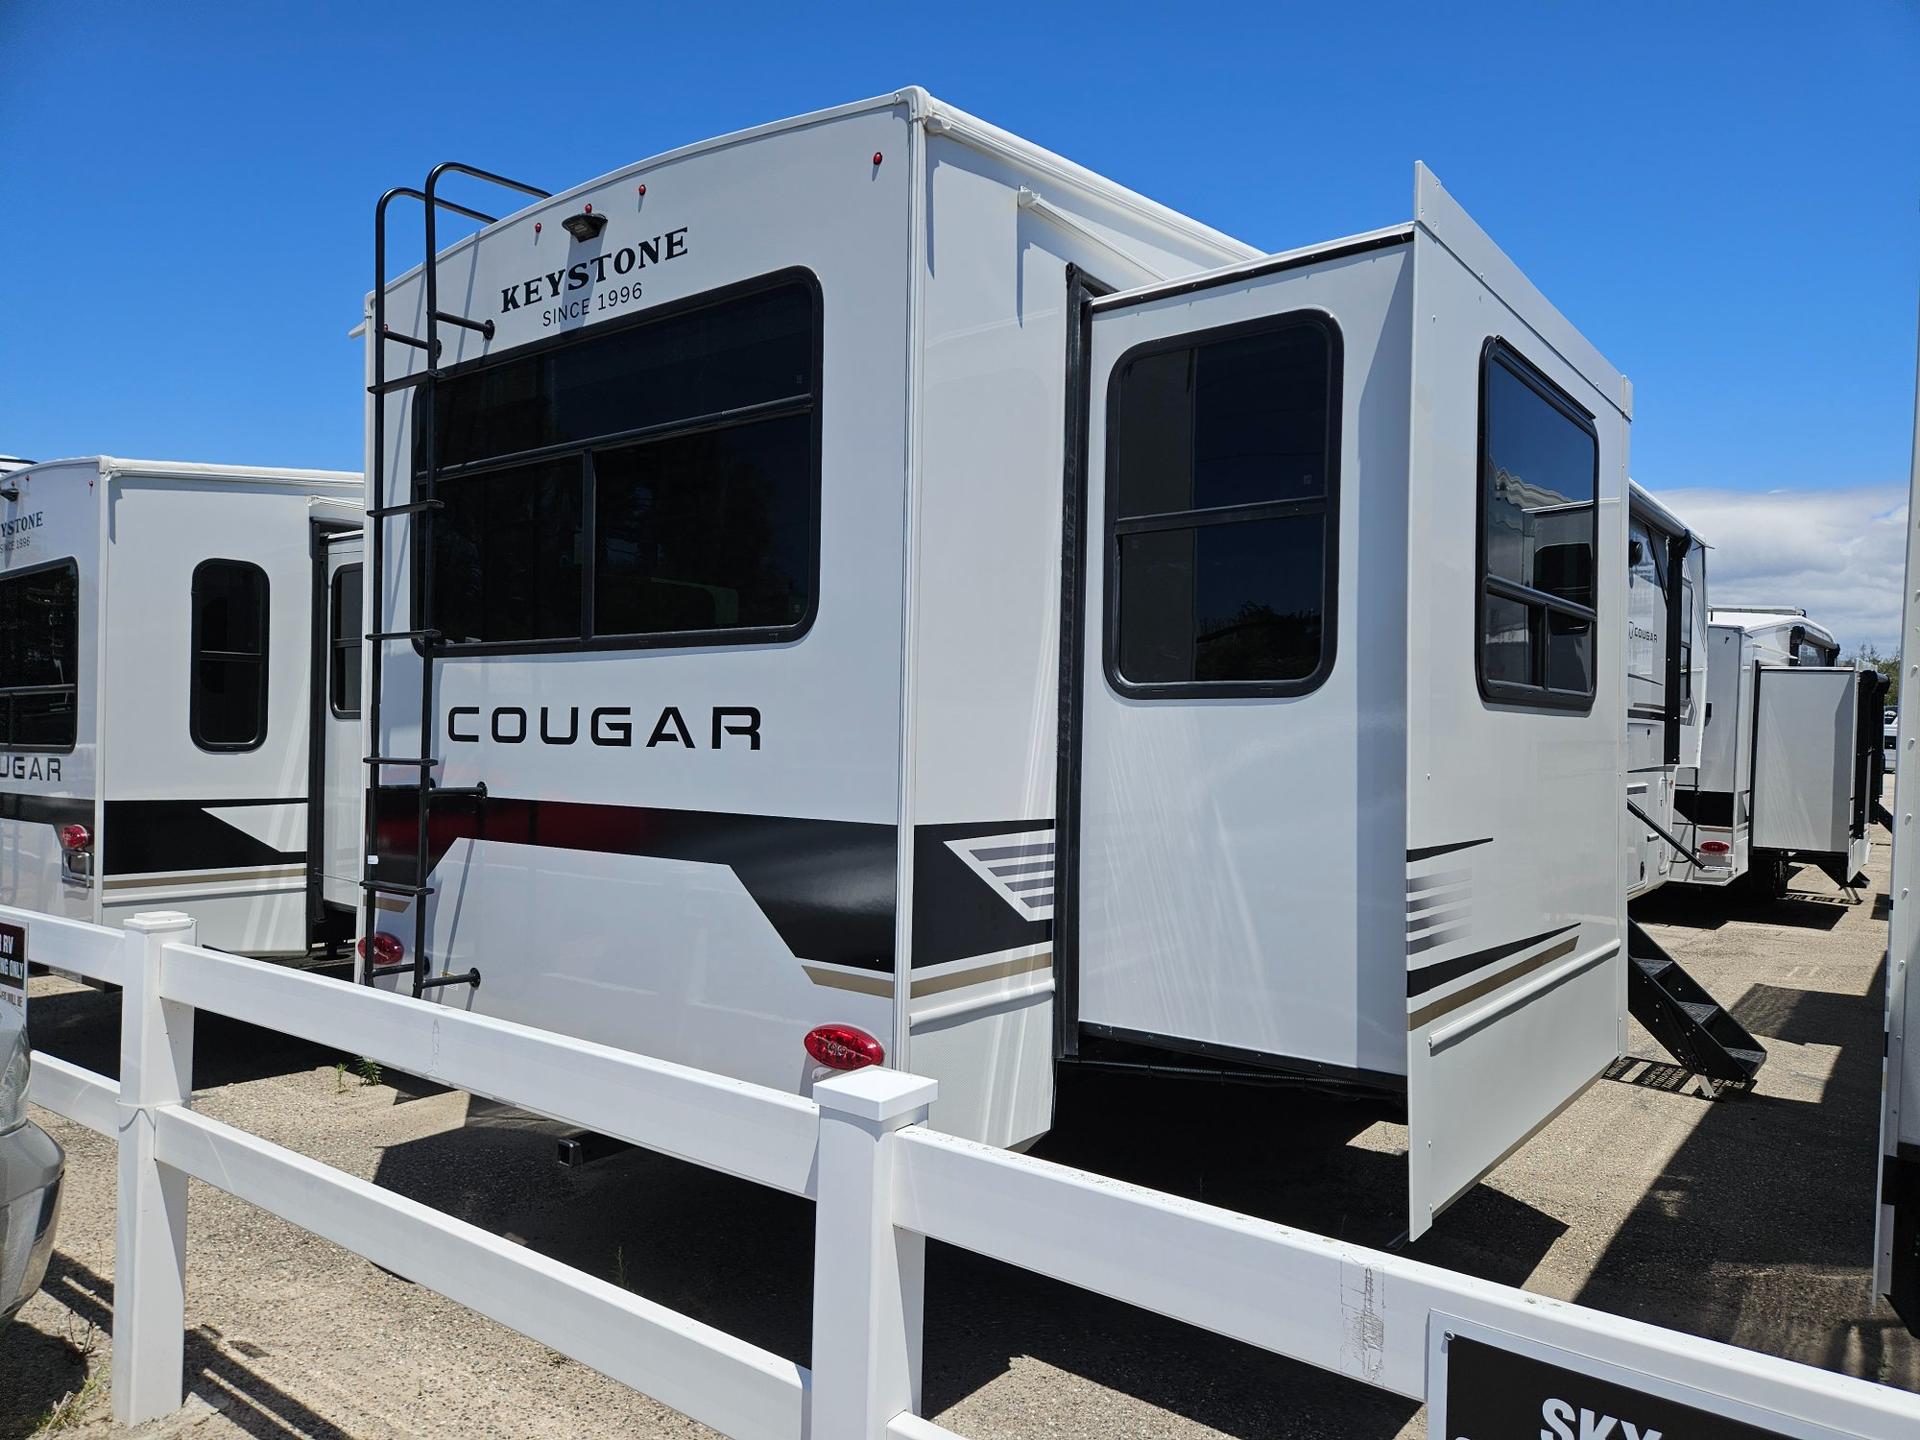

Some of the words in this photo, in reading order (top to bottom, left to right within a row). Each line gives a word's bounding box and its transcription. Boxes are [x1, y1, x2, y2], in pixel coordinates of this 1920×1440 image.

[501, 227, 688, 313] KEYSTONE
[542, 297, 589, 327] SINCE
[598, 282, 642, 310] 1996
[1634, 627, 1658, 643] COUGAR
[448, 706, 761, 750] COUGAR
